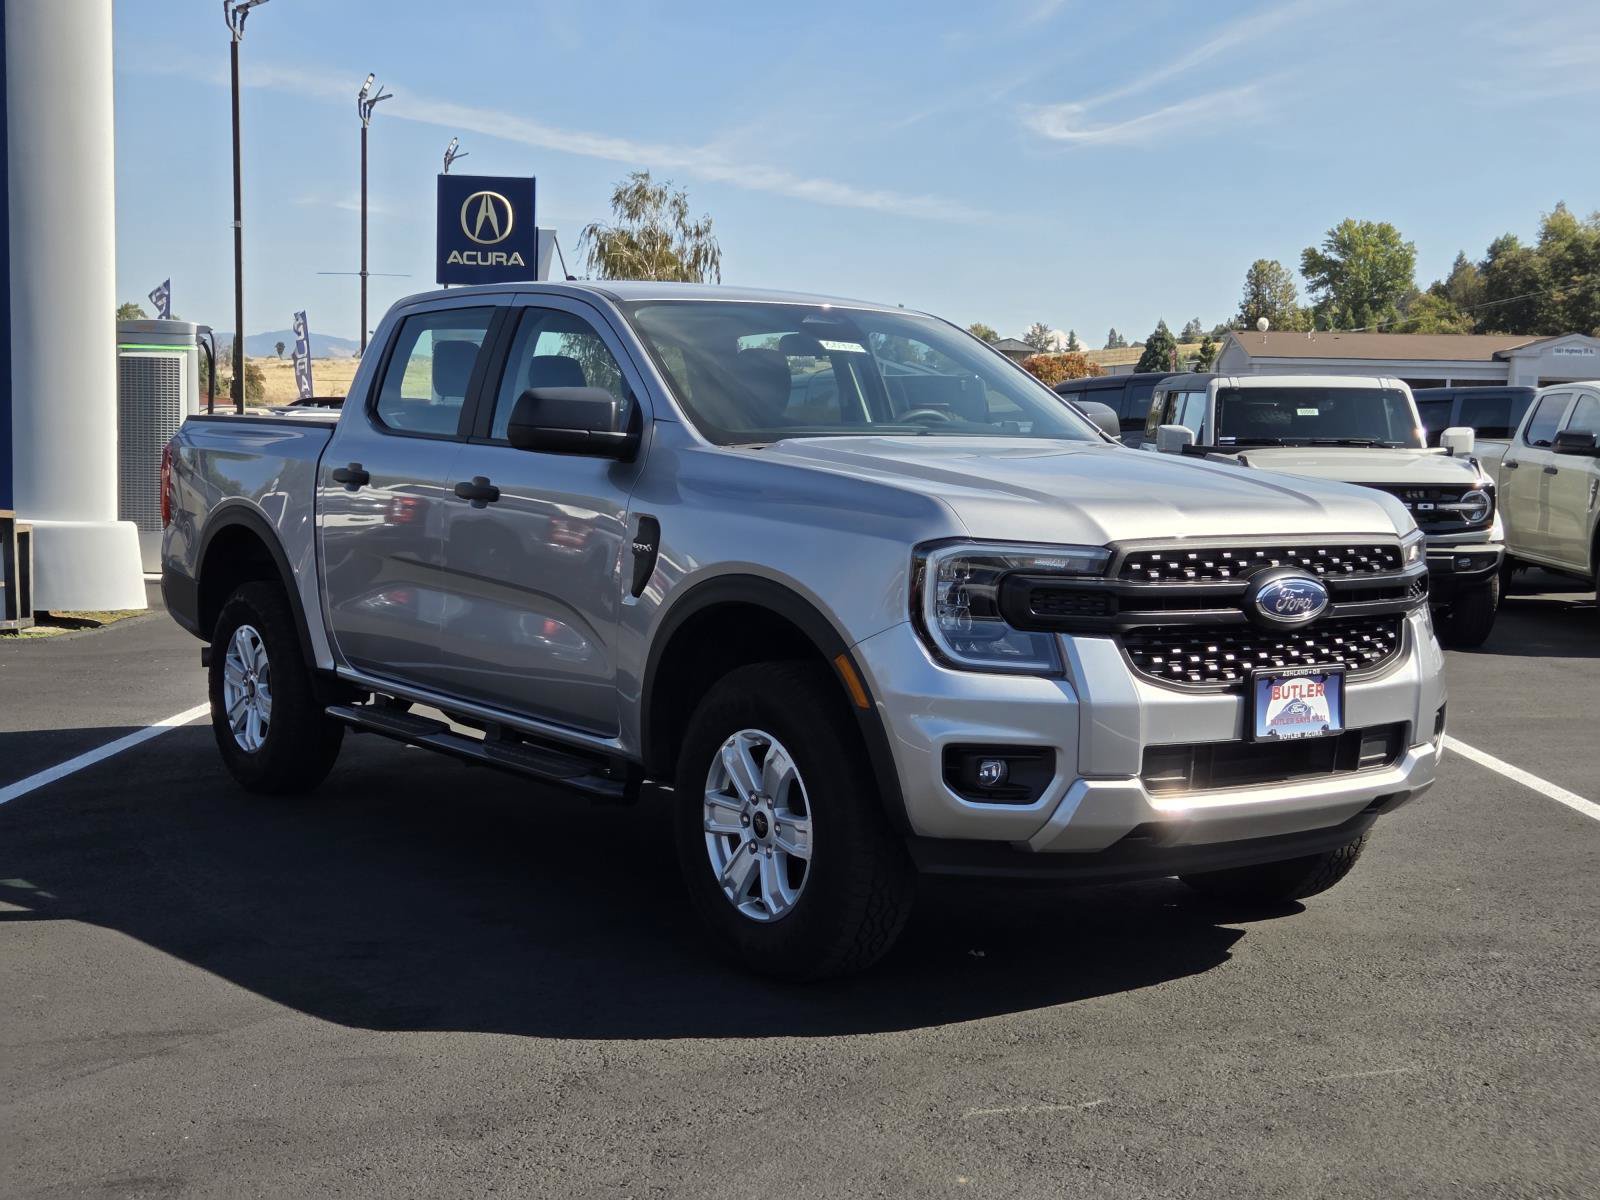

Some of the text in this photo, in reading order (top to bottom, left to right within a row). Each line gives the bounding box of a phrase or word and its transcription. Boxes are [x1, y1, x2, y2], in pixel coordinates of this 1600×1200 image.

[446, 250, 525, 267] ACURA
[1275, 587, 1314, 613] Ford
[1271, 682, 1324, 700] BUTLER
